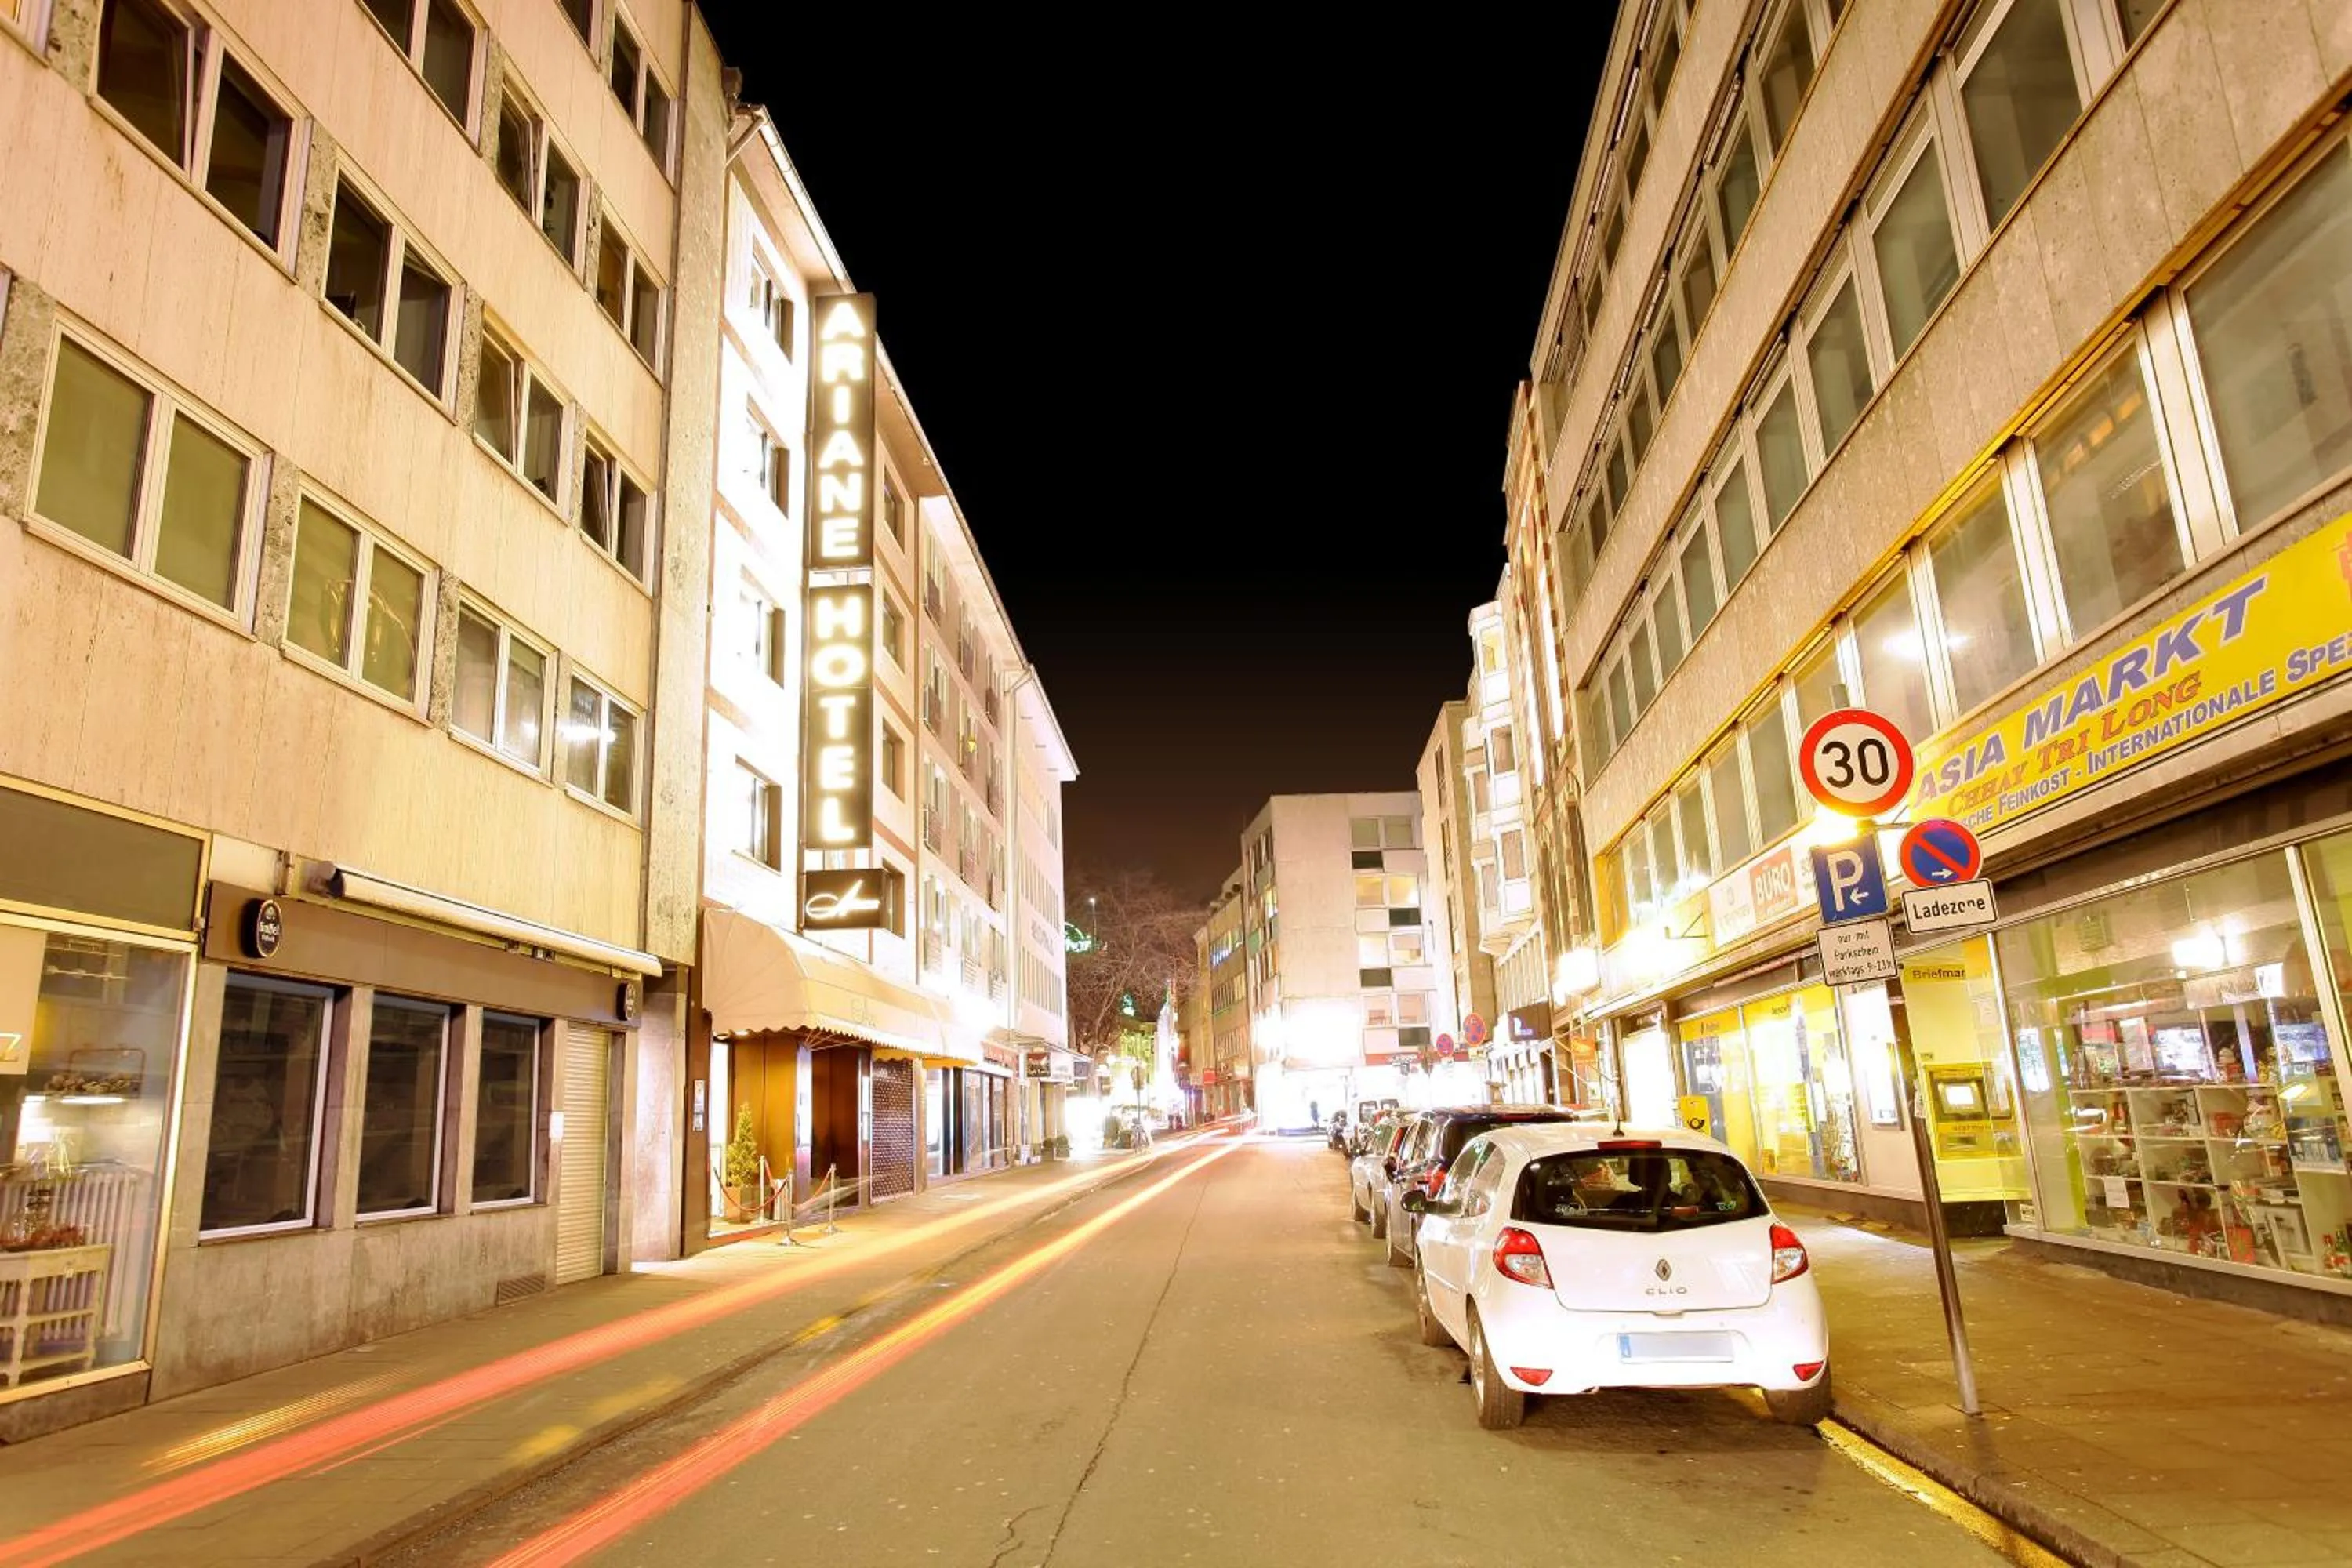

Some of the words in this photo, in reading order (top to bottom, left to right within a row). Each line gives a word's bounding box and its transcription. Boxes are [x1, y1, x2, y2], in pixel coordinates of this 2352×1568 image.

[818, 300, 866, 559] ARIANE
[811, 596, 867, 843] HOTEL
[1914, 732, 2006, 809] ASIA
[2023, 573, 2270, 750] MARKT
[1998, 767, 2071, 816] FEINKOST
[2087, 669, 2277, 775] INTERNATIONALE
[2038, 728, 2092, 773] TRI
[2100, 670, 2202, 742] LONG
[1821, 738, 1889, 789] 30
[1826, 850, 1864, 912] P
[1913, 897, 1986, 920] Ladezone
